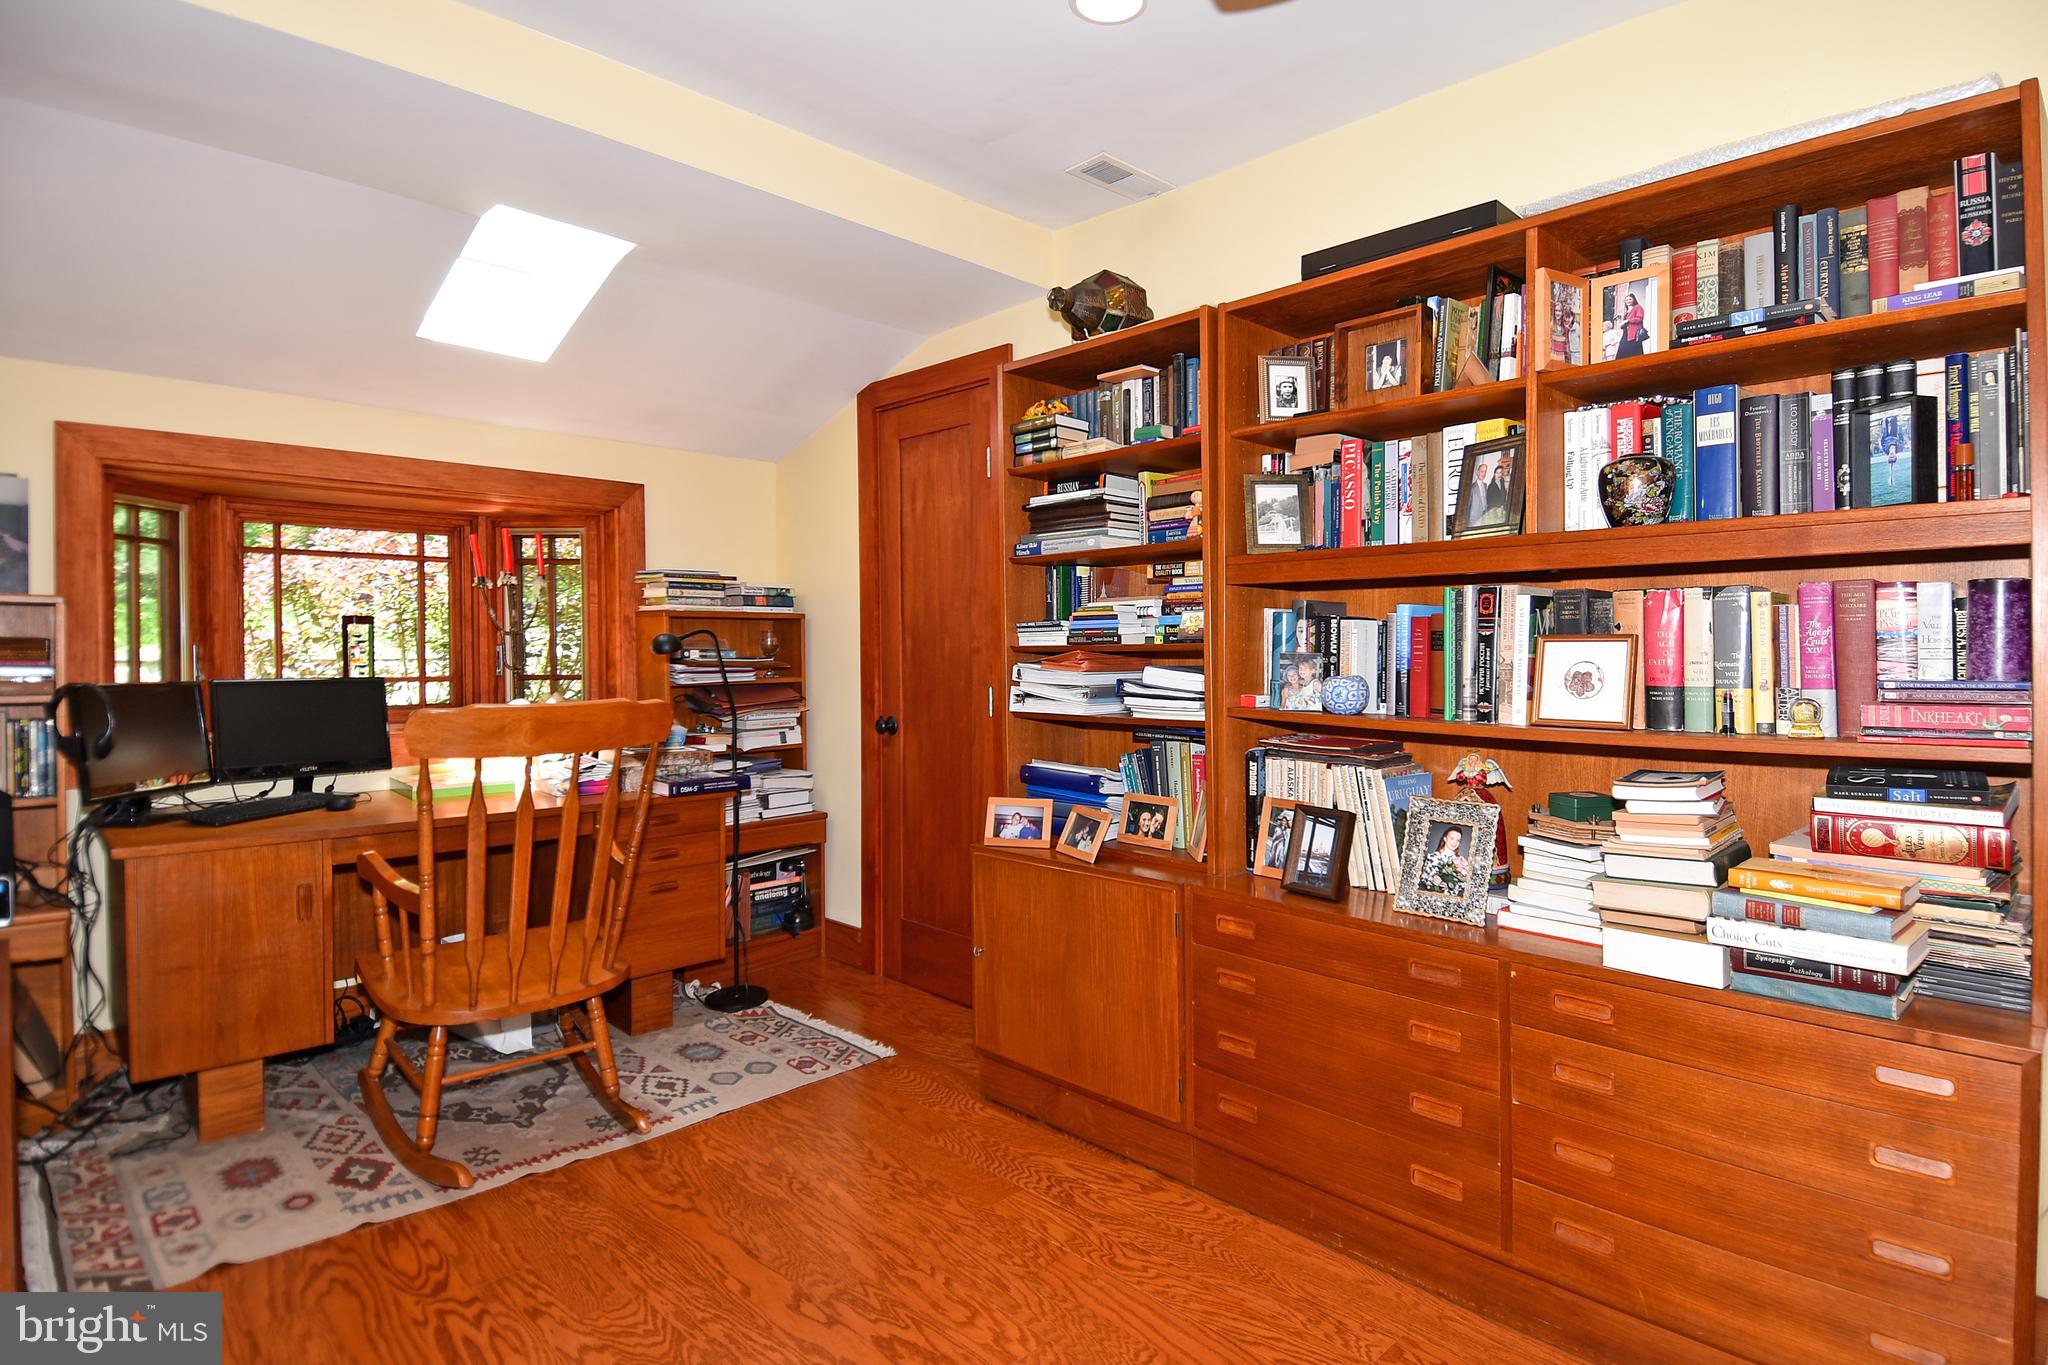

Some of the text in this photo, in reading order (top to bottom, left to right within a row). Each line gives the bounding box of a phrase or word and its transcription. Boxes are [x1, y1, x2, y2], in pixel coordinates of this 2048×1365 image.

[1998, 175, 2023, 184] HISTOR
[1960, 196, 1991, 208] RUSSIA
[1959, 210, 1992, 220] RUSSIANS
[1803, 227, 1813, 289] Stories to Enjoy
[1819, 260, 1829, 298] CURTAIN
[1902, 293, 1923, 304] KING
[1923, 291, 1943, 301] LEAR
[1734, 311, 1761, 325] Salt
[1707, 393, 1722, 405] HUGO
[1947, 365, 1963, 421] Ernest Hemingway
[1709, 417, 1720, 429] LES
[1790, 403, 1799, 447] LEO TOLSTOY
[1616, 418, 1626, 458] PHYSIC
[1625, 417, 1634, 455] UNDERSTAN
[1674, 408, 1683, 481] THE ROMANCE
[1698, 428, 1734, 443] MISÉRABLES
[1417, 461, 1426, 473] The
[1565, 450, 1576, 490] Falling Up
[1754, 417, 1763, 508] THE BROTHERS KARAMAZOV
[1343, 442, 1358, 511] PICASSO
[1417, 473, 1426, 498] Republic
[1373, 462, 1382, 526] The Polish Way
[1417, 505, 1425, 529] PLATO
[1155, 568, 1183, 577] QUALITY BOOK
[1804, 618, 1822, 630] The
[1954, 608, 1967, 638] James
[1330, 618, 1338, 654] BEOWULF
[1804, 625, 1832, 640] Age of
[1319, 632, 1327, 654] TOLSTOY
[1399, 611, 1409, 684] COLD MOUNTAIN
[1804, 637, 1829, 648] Louis
[1805, 647, 1824, 655] XIV
[1647, 658, 1675, 667] FAITH
[1778, 688, 1788, 721] CALDER
[1909, 707, 1983, 726] INKHEART
[1249, 761, 1257, 796] URUGUAY
[1287, 766, 1296, 799] ALASKA
[1359, 770, 1368, 800] Primitive
[680, 785, 699, 793] DSM-5
[1388, 784, 1431, 802] URUGUAY
[1893, 790, 1921, 802] Salt
[1883, 806, 1958, 819] THE RED TENT
[754, 888, 789, 901] anatomy
[1805, 886, 1862, 899] EDITH HAMILTON
[1711, 925, 1783, 949] Choice Cuts
[1754, 953, 1786, 966] Synopsis
[1788, 965, 1824, 978] Pathology
